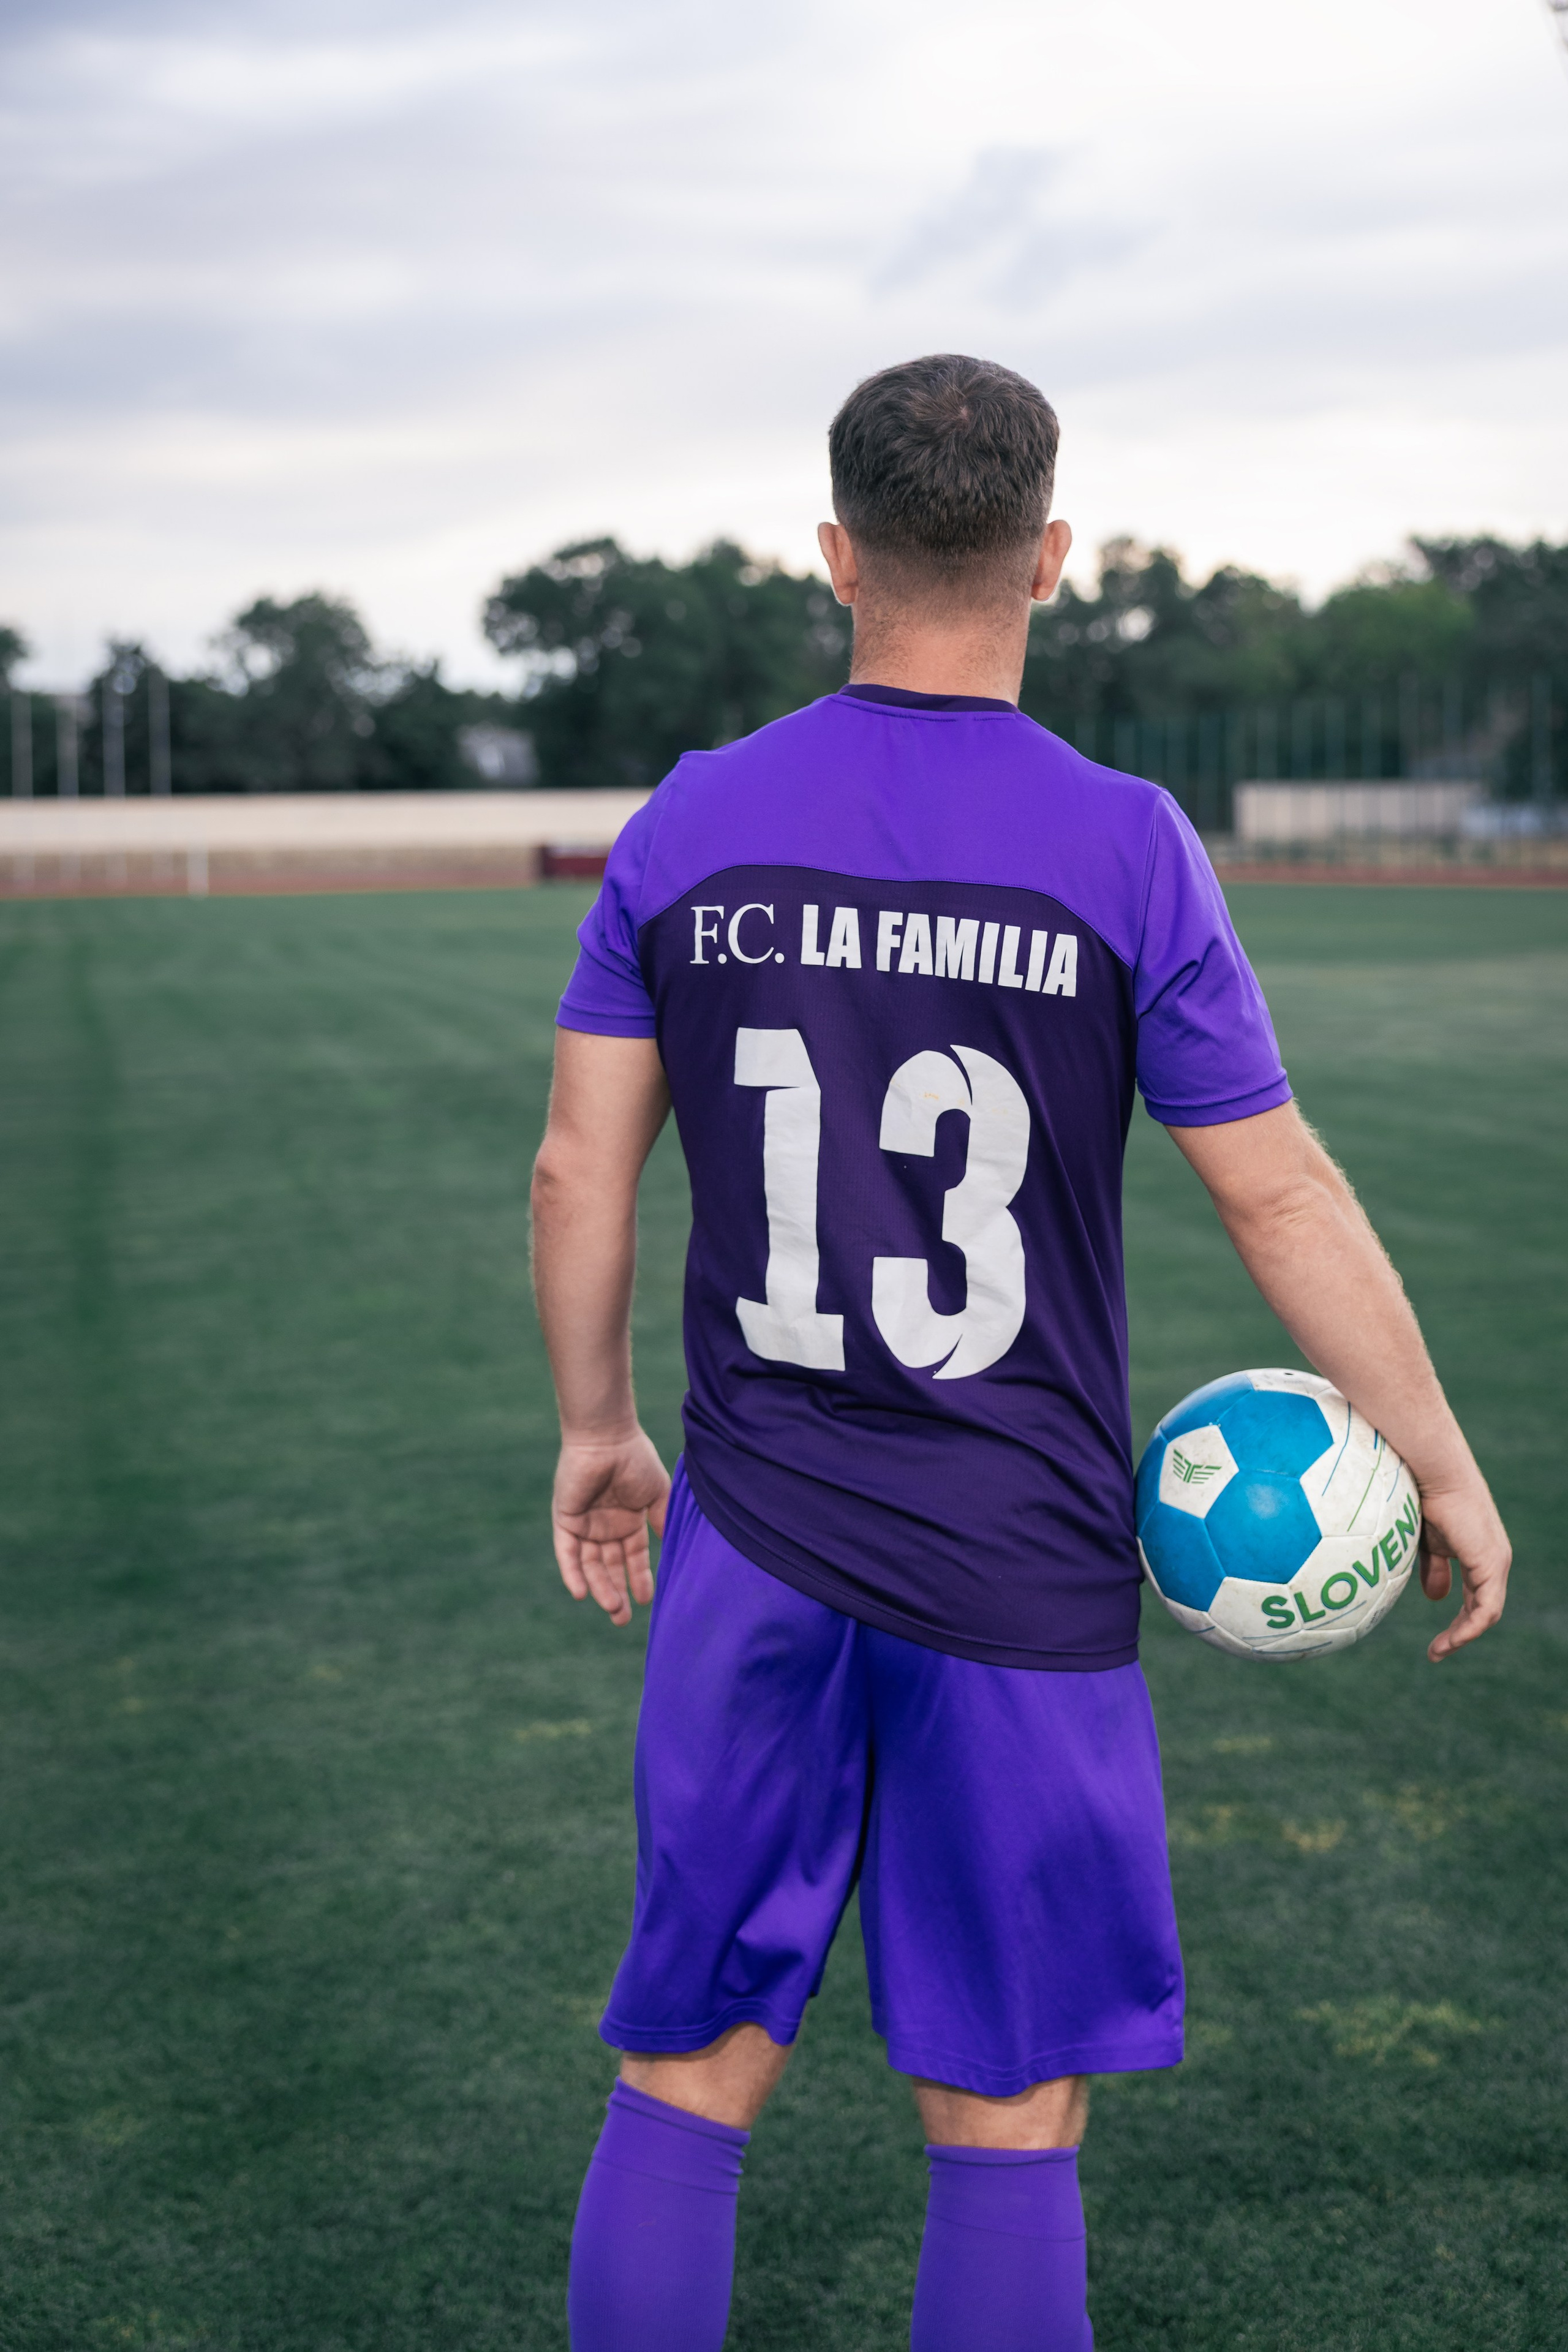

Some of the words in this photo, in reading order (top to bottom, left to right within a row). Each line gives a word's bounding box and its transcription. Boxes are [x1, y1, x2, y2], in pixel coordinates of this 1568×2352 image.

[690, 903, 785, 965] F.C.
[800, 904, 862, 969] LA
[876, 910, 1078, 997] FAMILIA
[734, 1027, 1031, 1380] 13
[1261, 1493, 1420, 1629] SLOVENI
